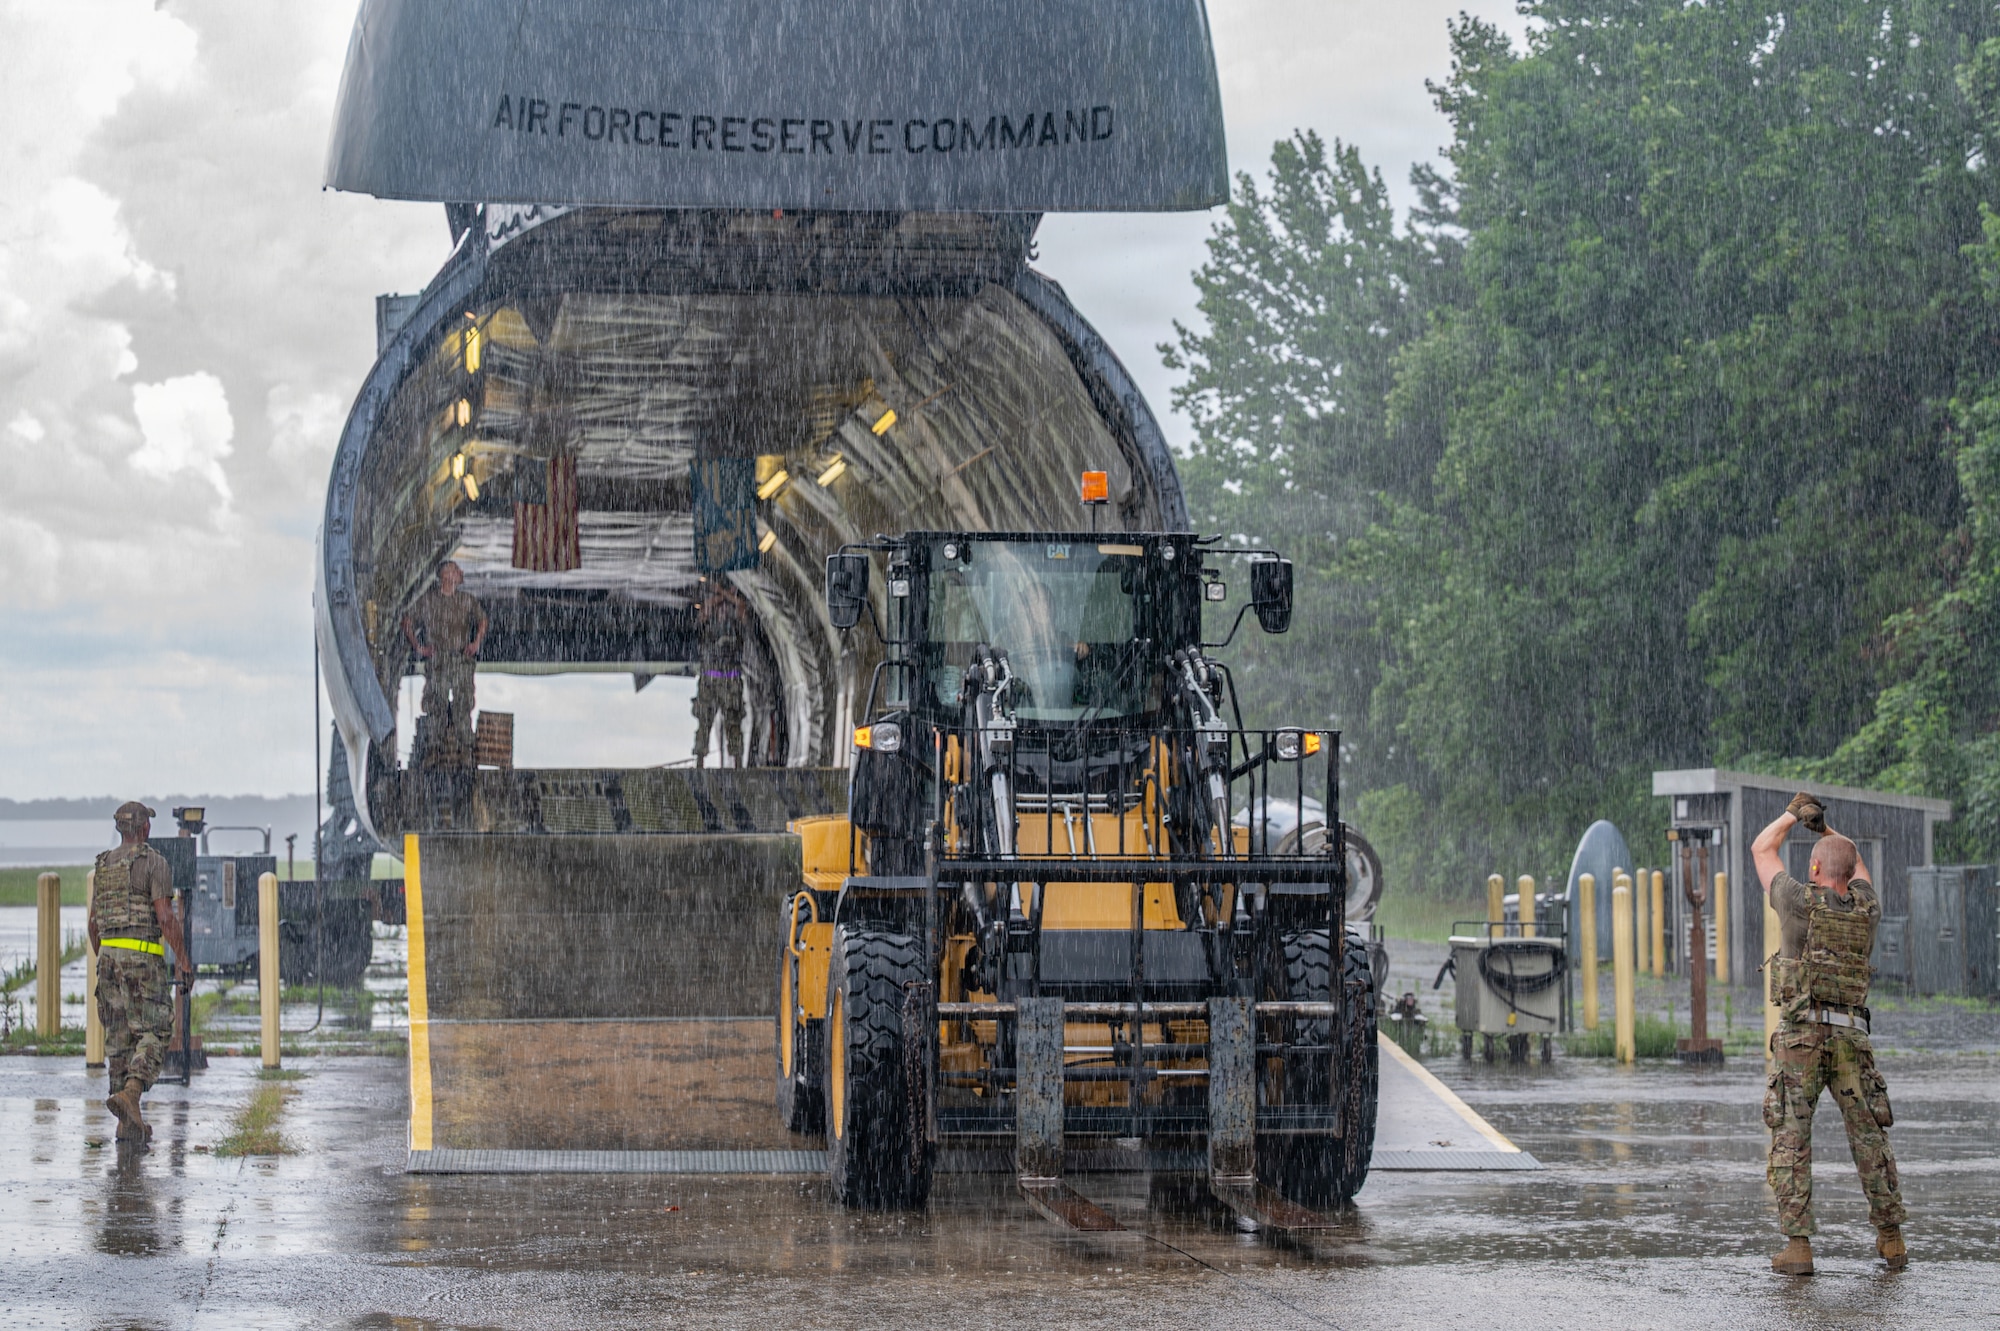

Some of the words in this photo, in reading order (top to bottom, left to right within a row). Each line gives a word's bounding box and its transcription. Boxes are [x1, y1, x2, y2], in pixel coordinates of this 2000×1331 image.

[494, 94, 548, 135] AIR
[558, 103, 682, 148] FORCE
[691, 115, 893, 154] RESERVE
[904, 105, 1113, 153] COMMAND
[1047, 544, 1071, 559] CAT
